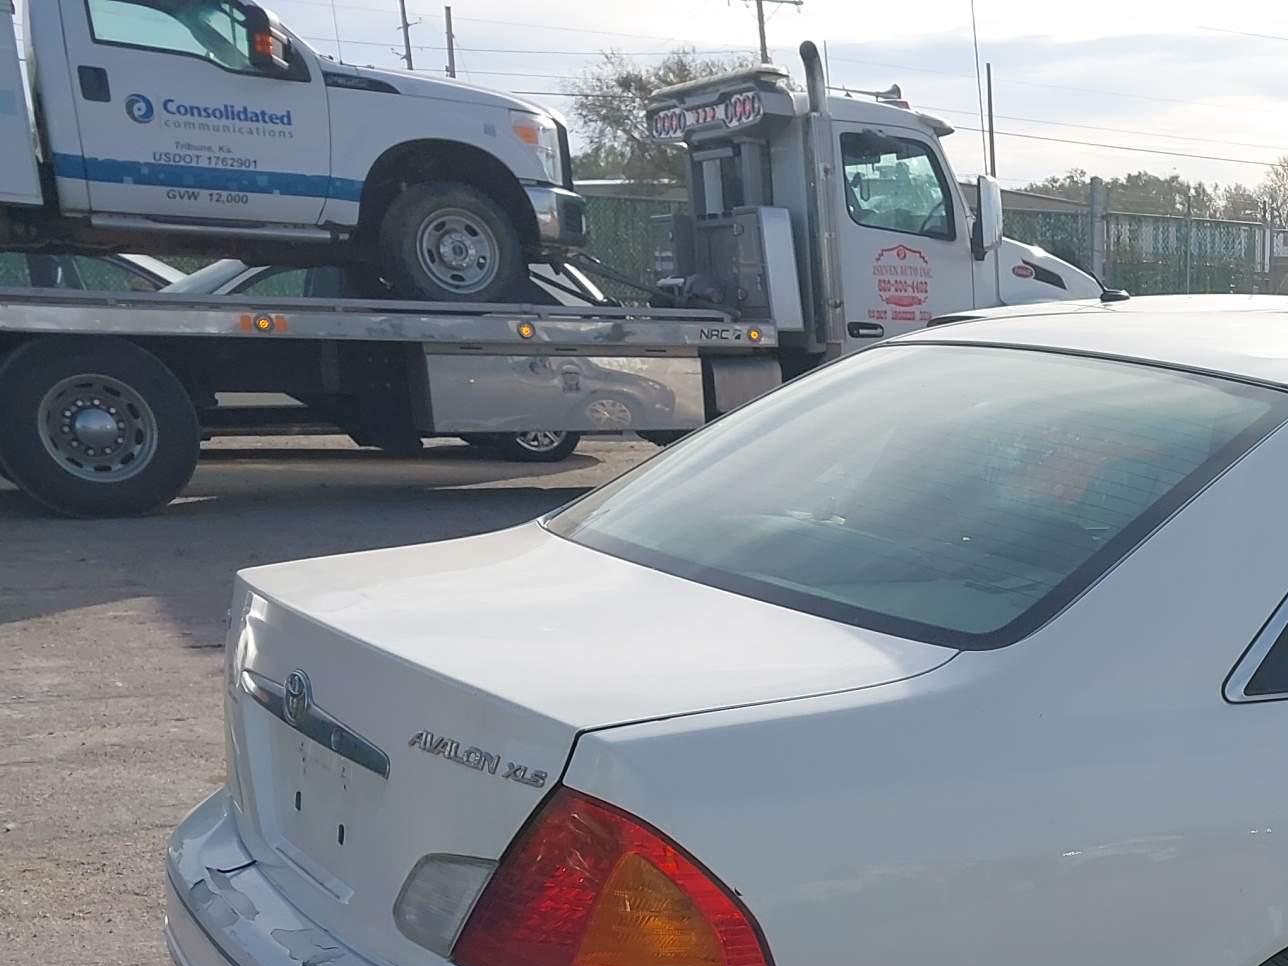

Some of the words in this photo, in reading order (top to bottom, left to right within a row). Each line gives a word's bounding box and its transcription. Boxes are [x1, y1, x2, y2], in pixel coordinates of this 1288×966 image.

[162, 98, 293, 126] Consolidated
[163, 119, 295, 139] communications
[152, 152, 202, 165] USDOT
[207, 156, 258, 169] 1762901
[166, 189, 200, 201] GVW
[208, 193, 249, 205] 12,000
[700, 328, 730, 340] NRC
[408, 729, 501, 775] AVALON
[501, 762, 548, 788] XLS
